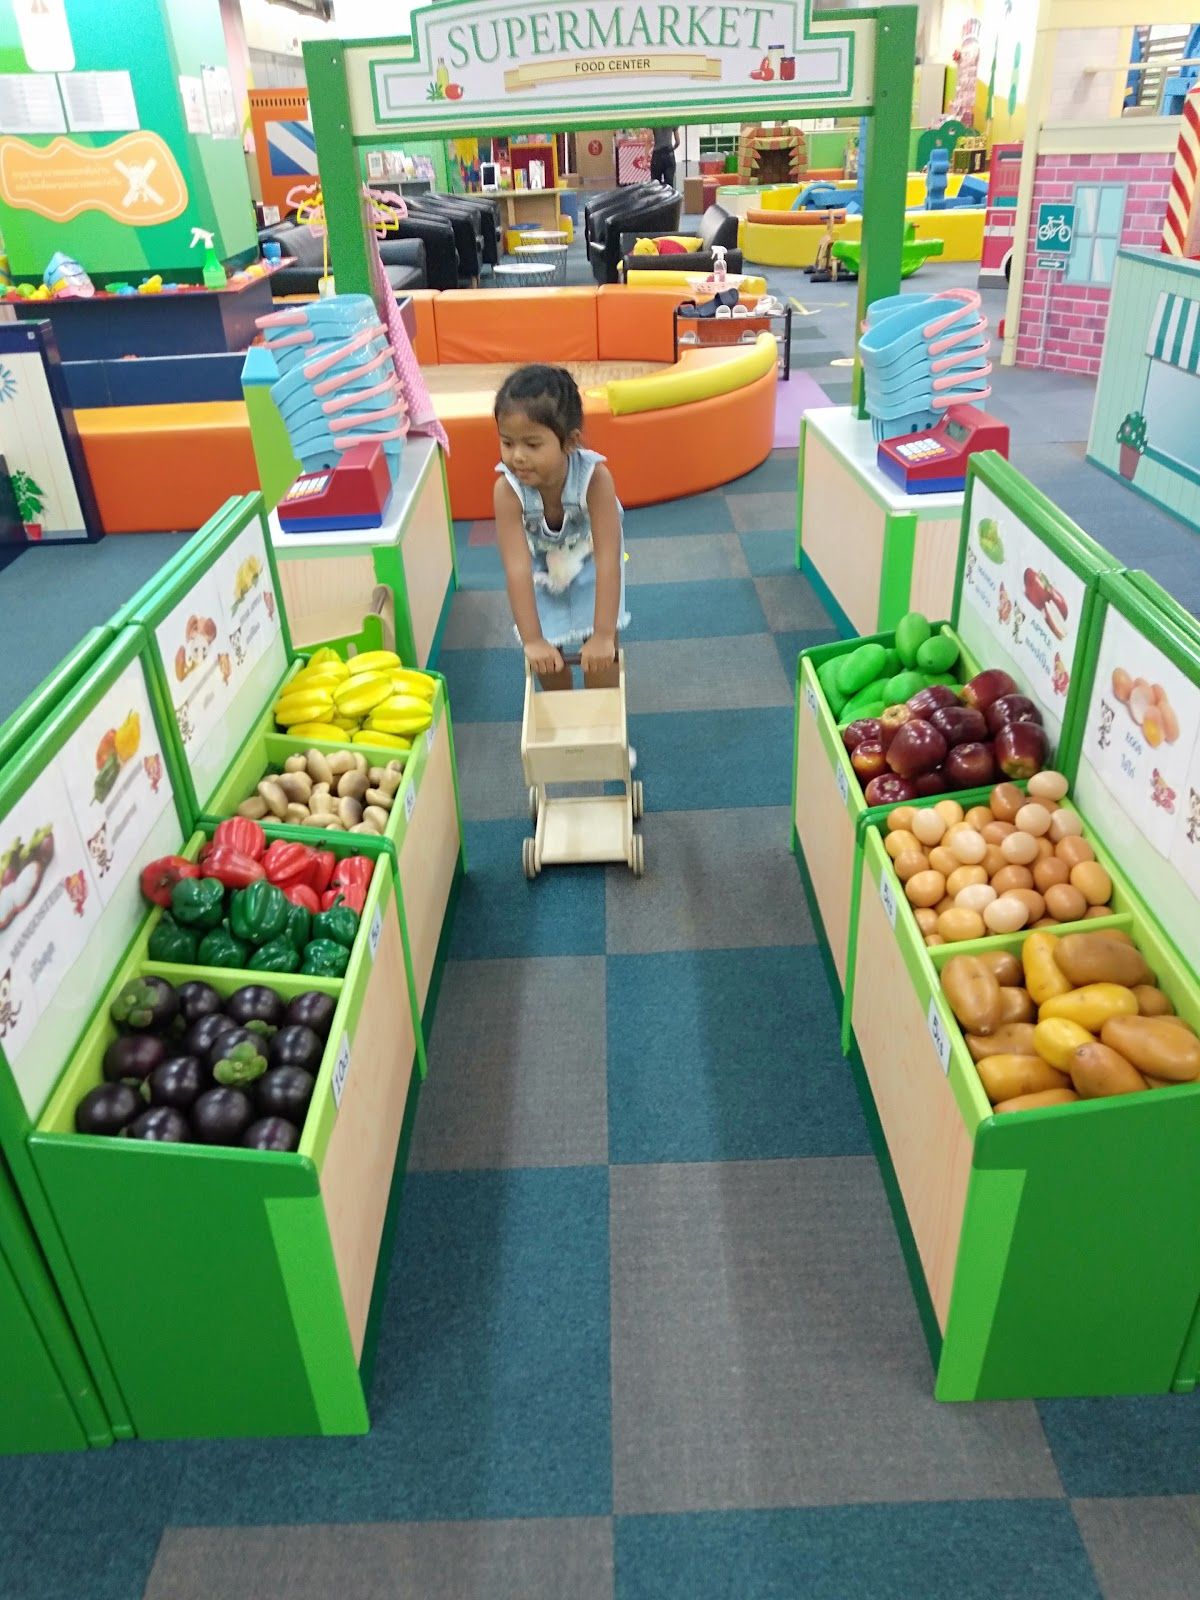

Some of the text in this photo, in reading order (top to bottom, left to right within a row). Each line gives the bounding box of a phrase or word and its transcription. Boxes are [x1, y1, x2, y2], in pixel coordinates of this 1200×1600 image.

[447, 5, 774, 69] SUPERMARKET
[575, 58, 651, 72] FOOD CENTER
